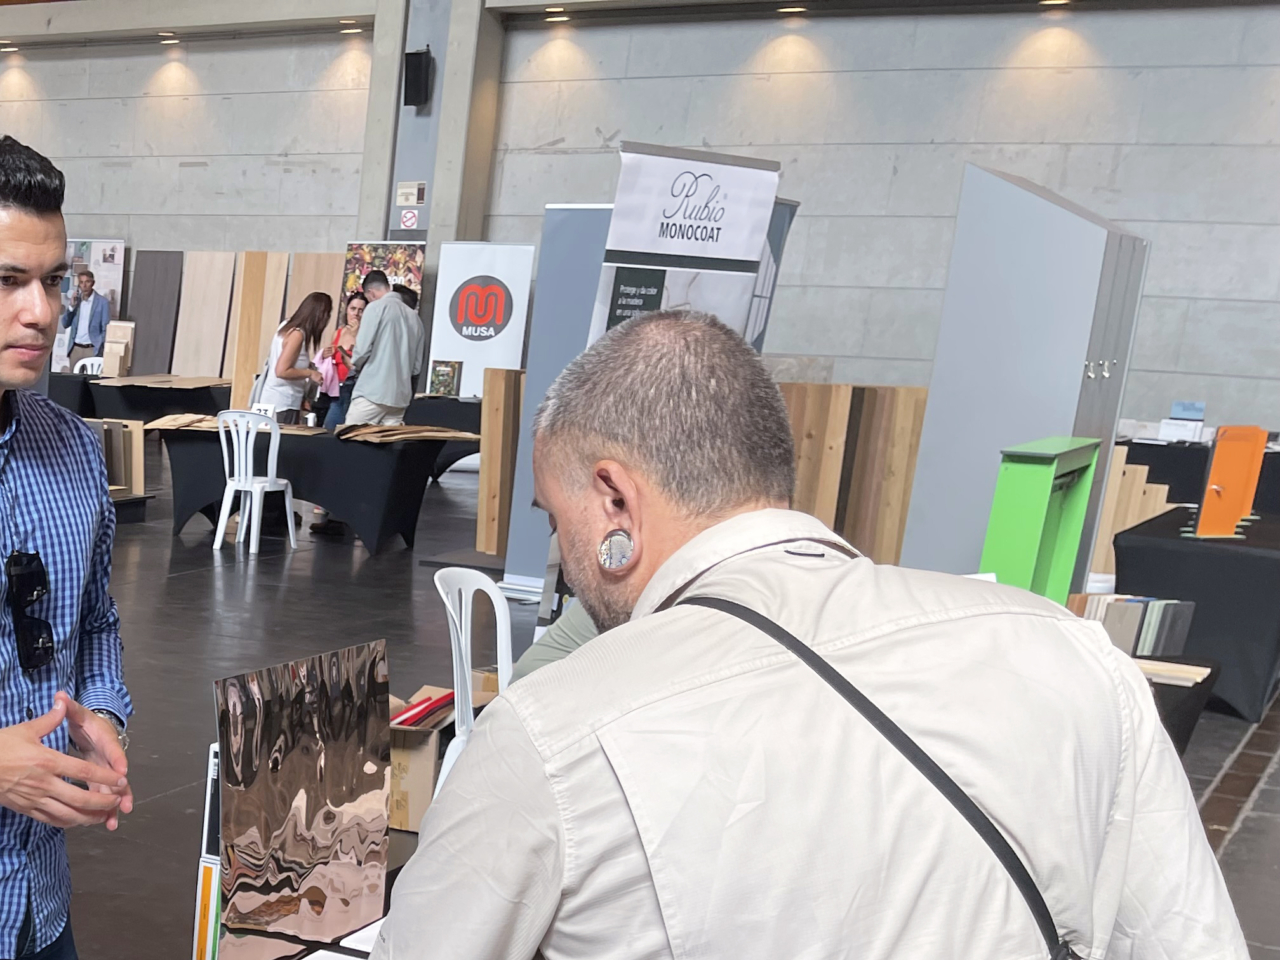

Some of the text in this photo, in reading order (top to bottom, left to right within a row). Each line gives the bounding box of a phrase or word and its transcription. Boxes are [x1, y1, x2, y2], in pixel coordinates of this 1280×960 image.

[662, 171, 725, 223] Rubio
[658, 222, 722, 243] MONOCOAT
[462, 325, 495, 337] MUSA
